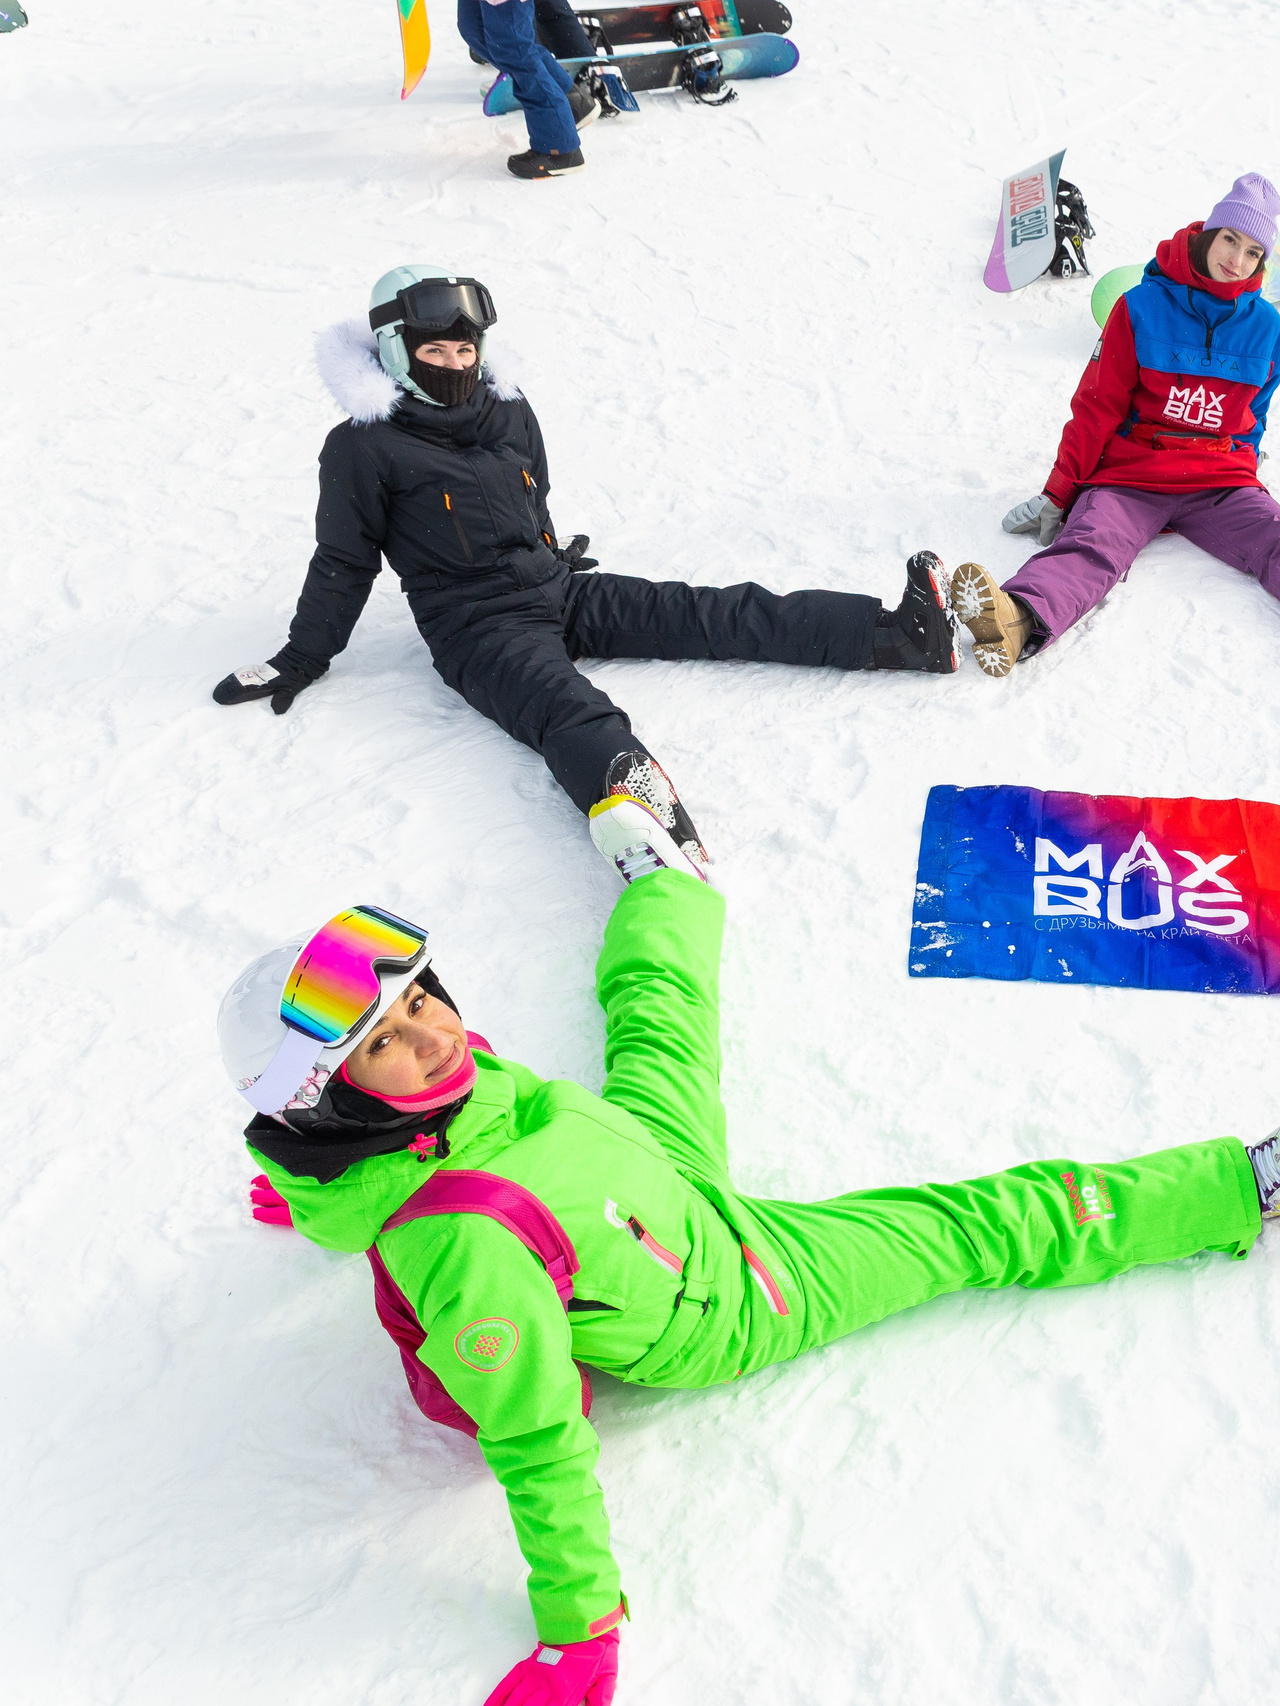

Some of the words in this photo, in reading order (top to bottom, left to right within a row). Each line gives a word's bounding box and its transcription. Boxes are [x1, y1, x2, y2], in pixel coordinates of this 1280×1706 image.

[1009, 173, 1045, 216] SANTA
[1011, 206, 1048, 247] CRUZ
[1171, 351, 1240, 373] XVOYA
[1162, 399, 1224, 428] BUS
[1168, 384, 1227, 411] MAX
[1034, 830, 1239, 893] MAX
[1033, 875, 1250, 935] BUS
[1049, 917, 1132, 933] ДРУЗЬЯМ
[1060, 1172, 1087, 1220] SNOW
[1081, 1184, 1101, 1212] HQ
[1095, 1168, 1112, 1210] ACTIVIT
